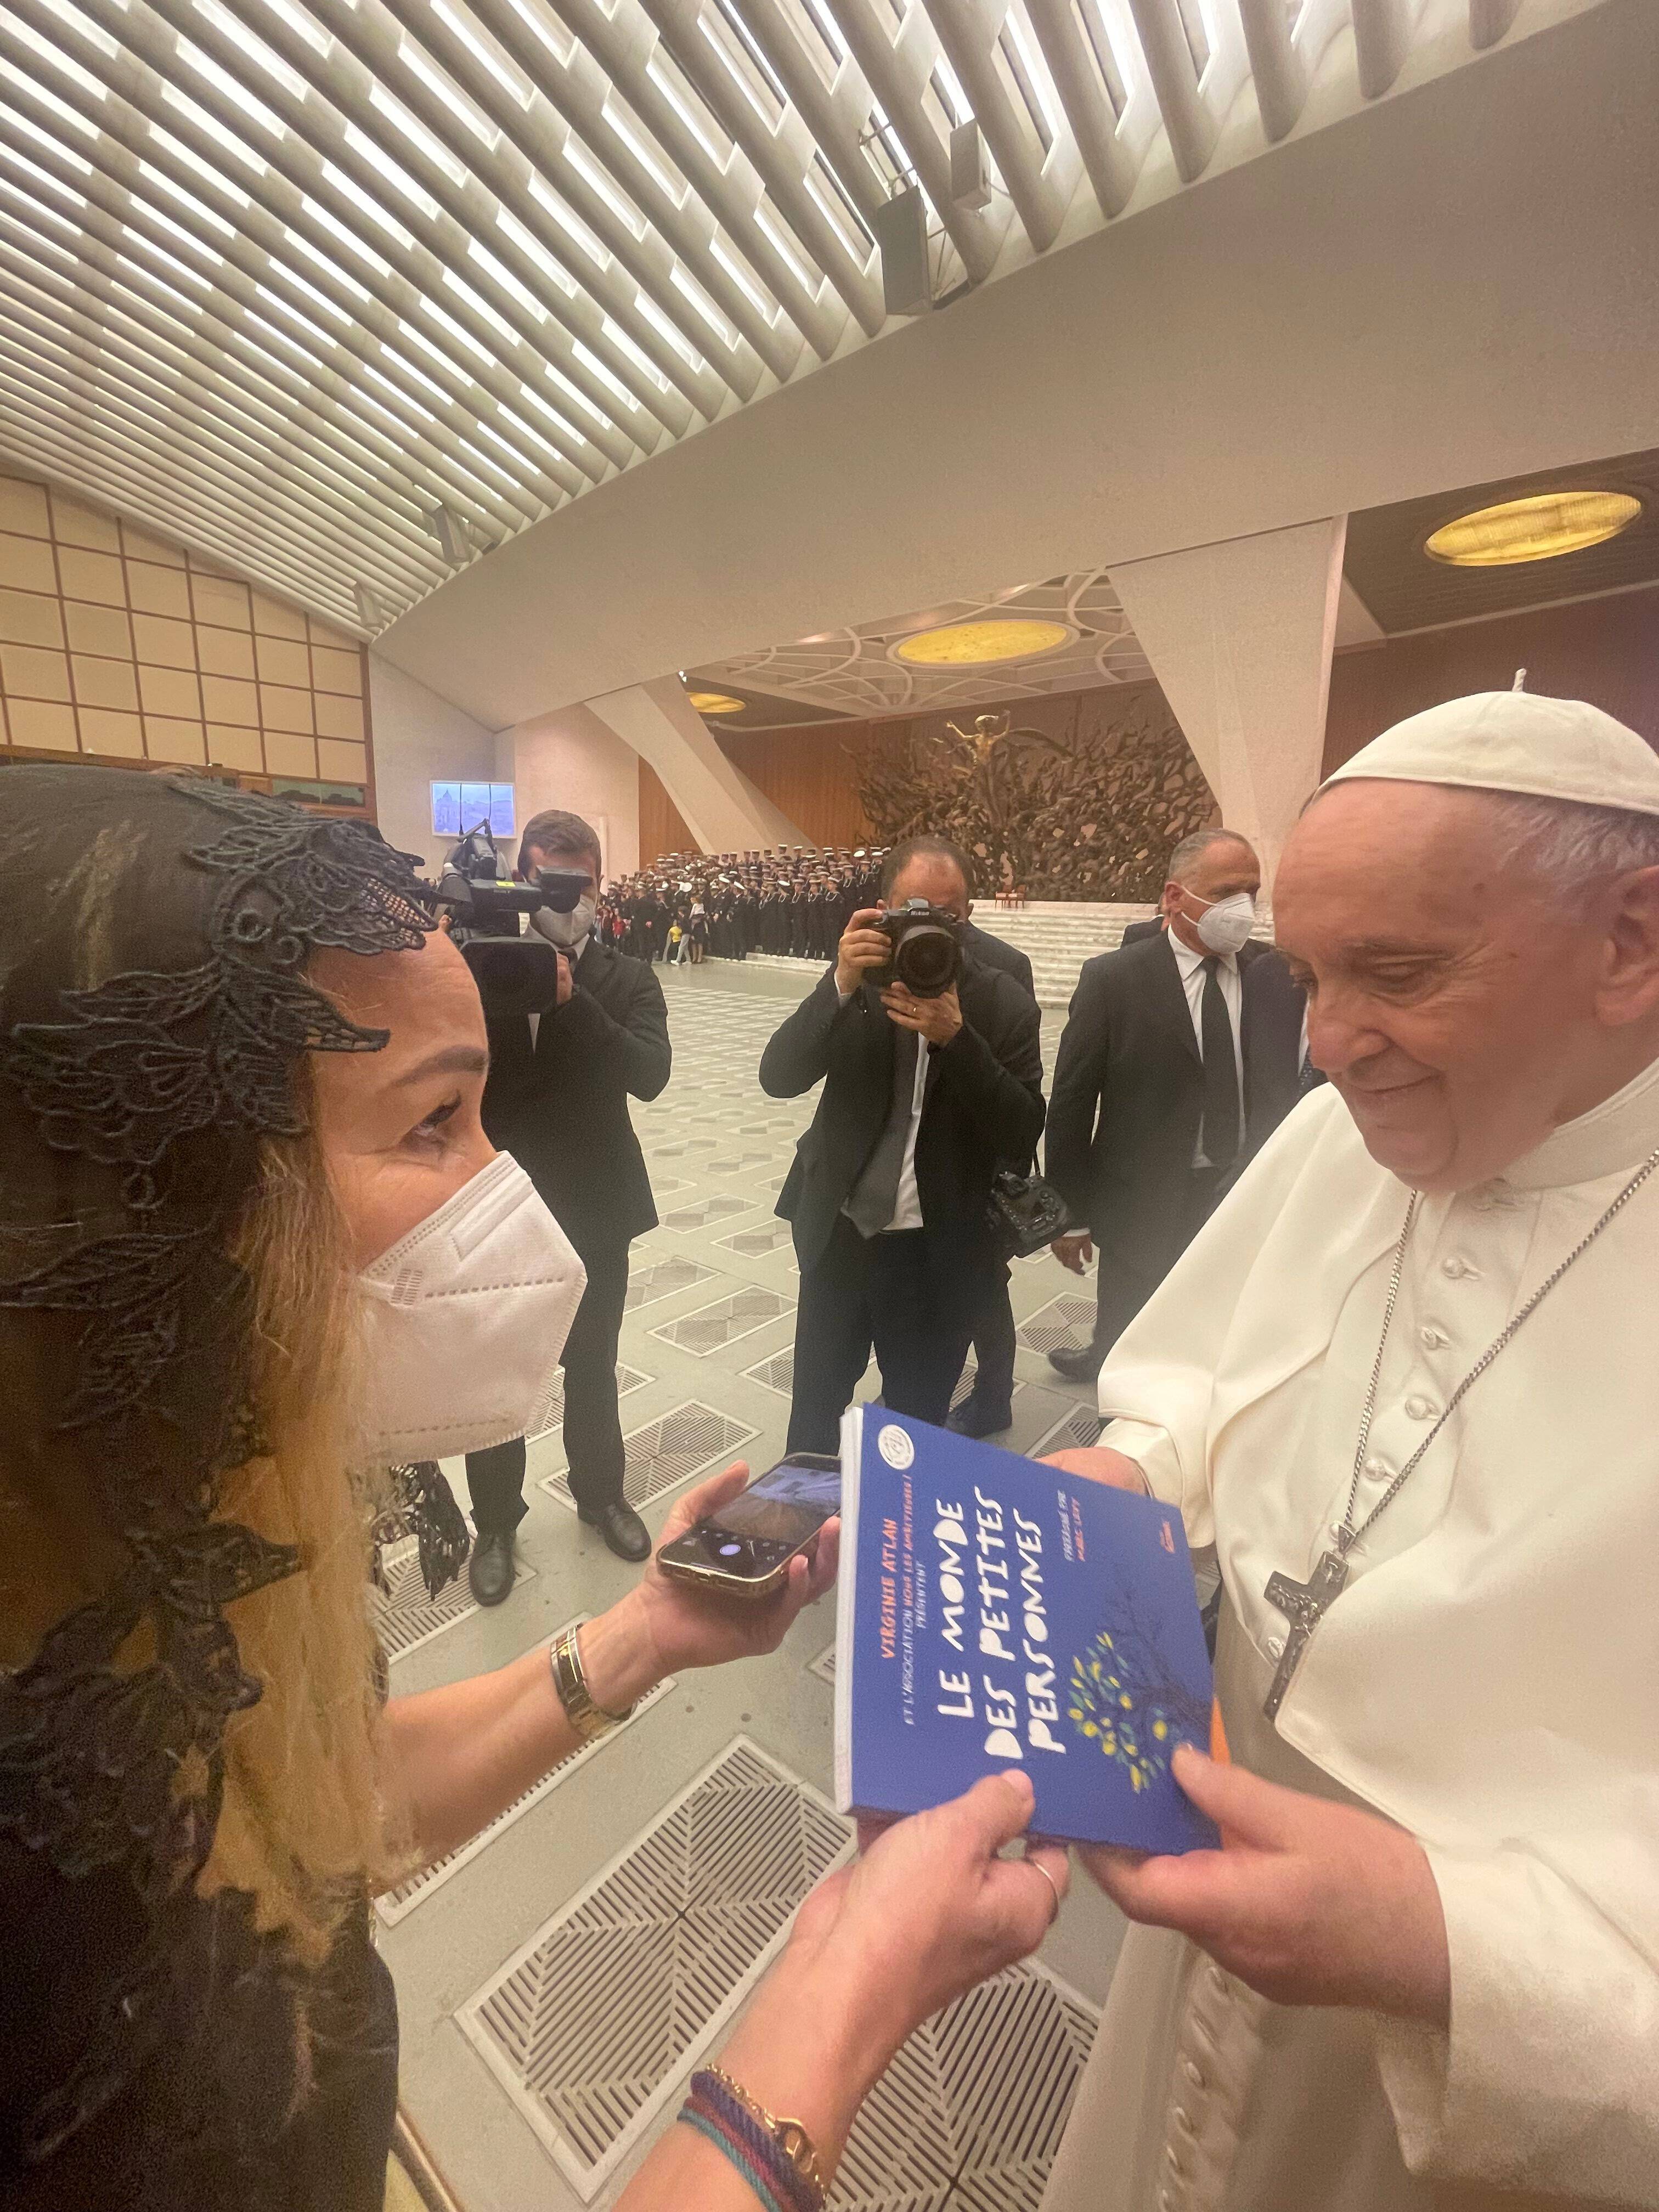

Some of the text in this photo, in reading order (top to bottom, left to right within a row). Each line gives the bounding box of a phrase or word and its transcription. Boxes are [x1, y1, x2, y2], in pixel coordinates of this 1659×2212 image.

[880, 1518, 898, 1658] VIRGINIE ATLAN
[903, 1553, 913, 1573] LES
[933, 1498, 974, 1718] LE MONDE
[974, 1485, 1024, 1759] DES PETITES
[1013, 1508, 1066, 1754] PERSONNES
[902, 1609, 914, 1704] L'ASSOCIATION
[903, 1707, 915, 1725] ET
